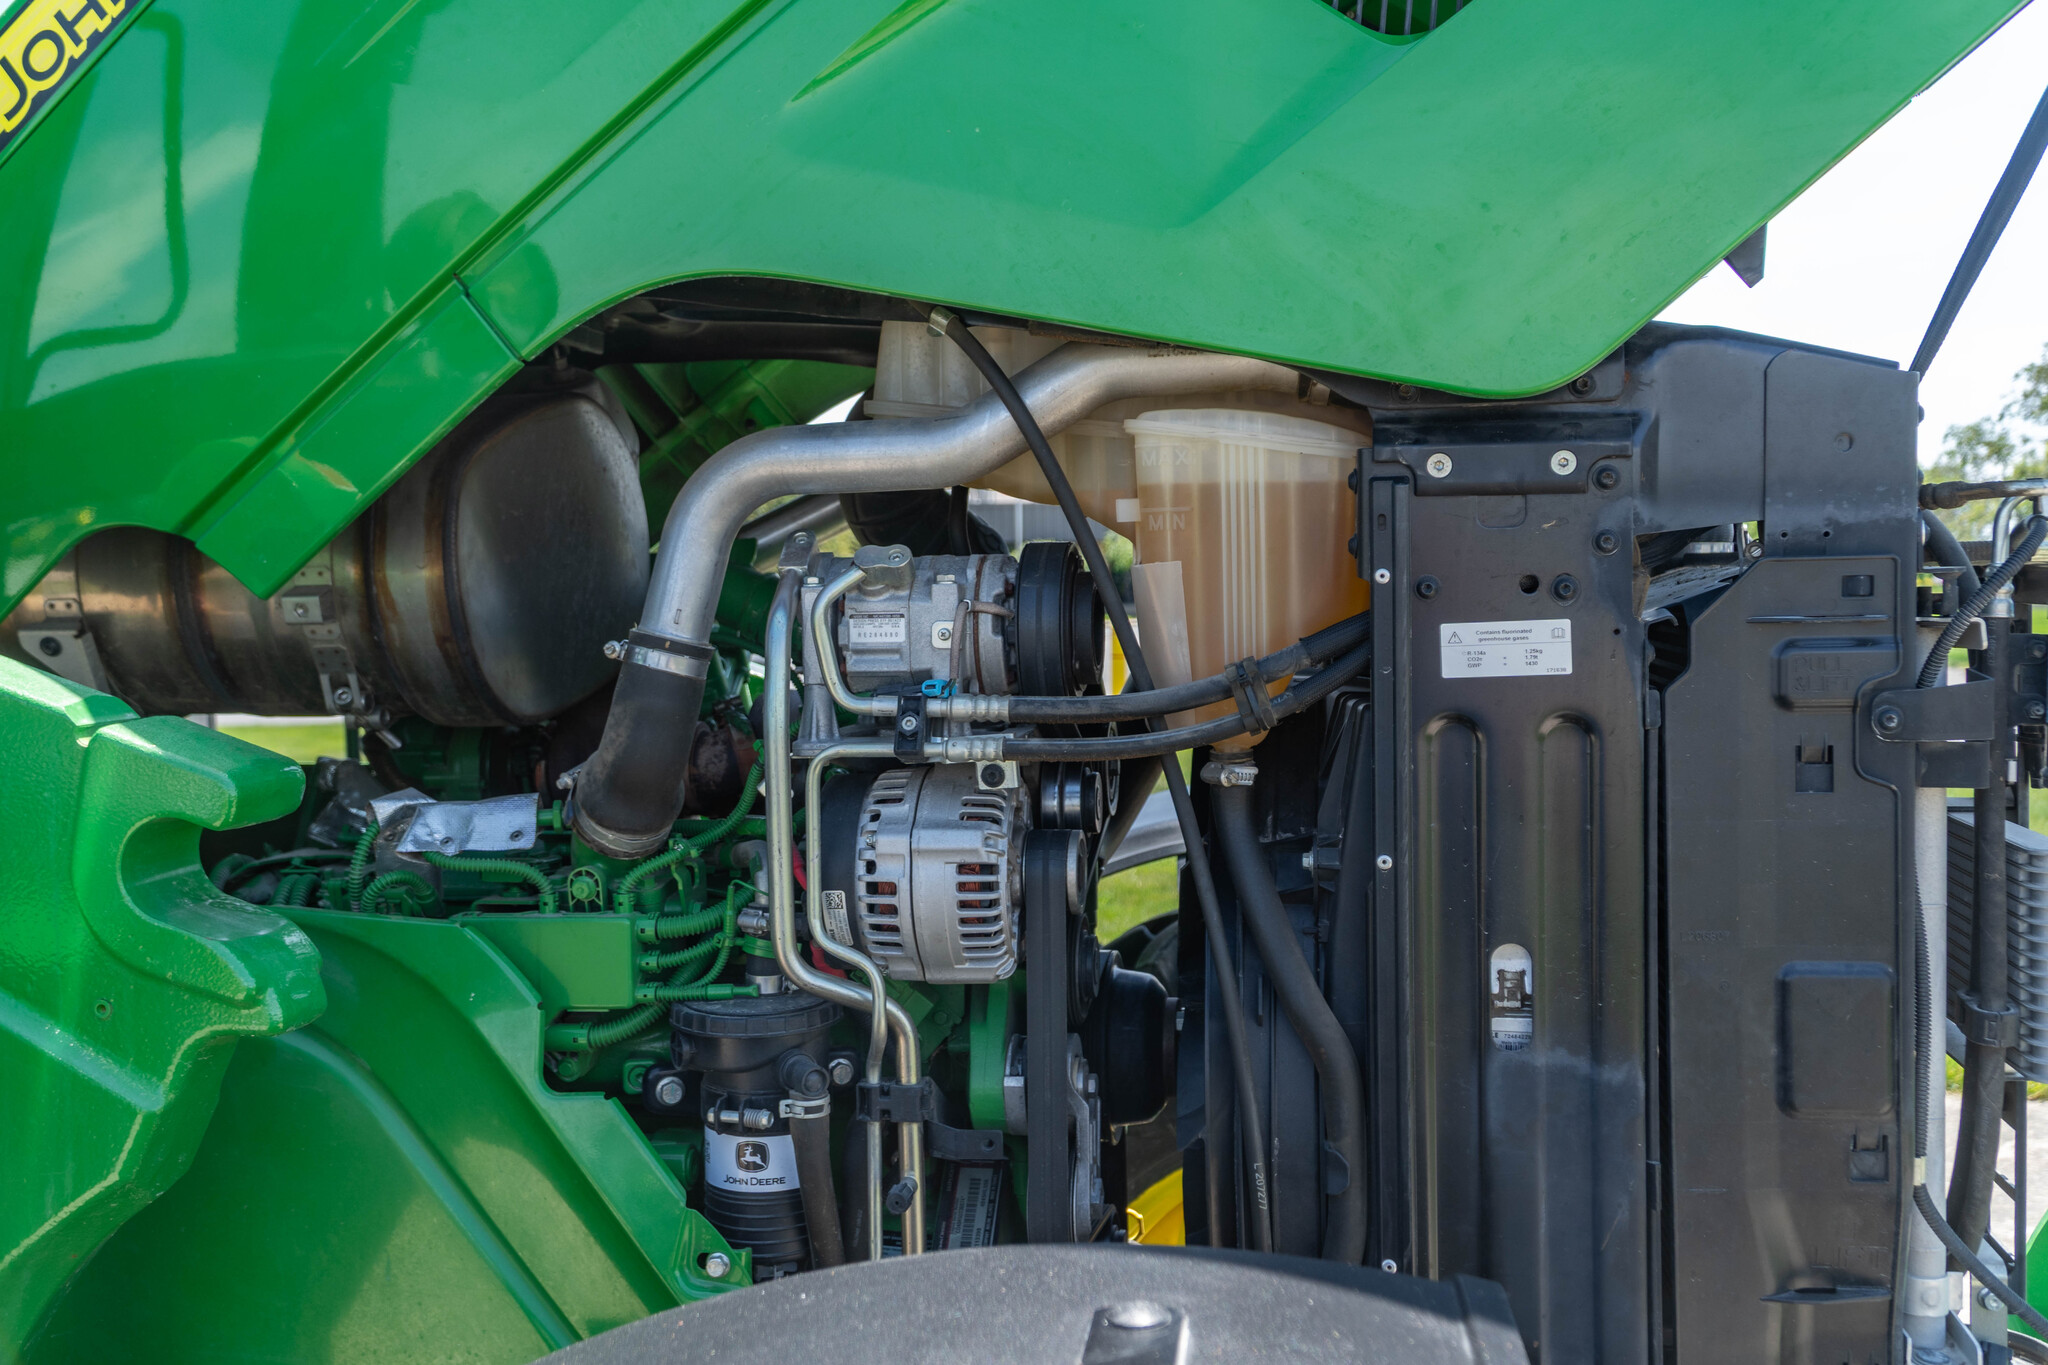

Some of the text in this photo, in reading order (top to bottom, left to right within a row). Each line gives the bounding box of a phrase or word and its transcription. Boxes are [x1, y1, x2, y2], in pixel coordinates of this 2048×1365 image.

[1141, 450, 1190, 466] MAX
[1149, 513, 1186, 530] MIN
[723, 1174, 786, 1186] JOHN DEERE
